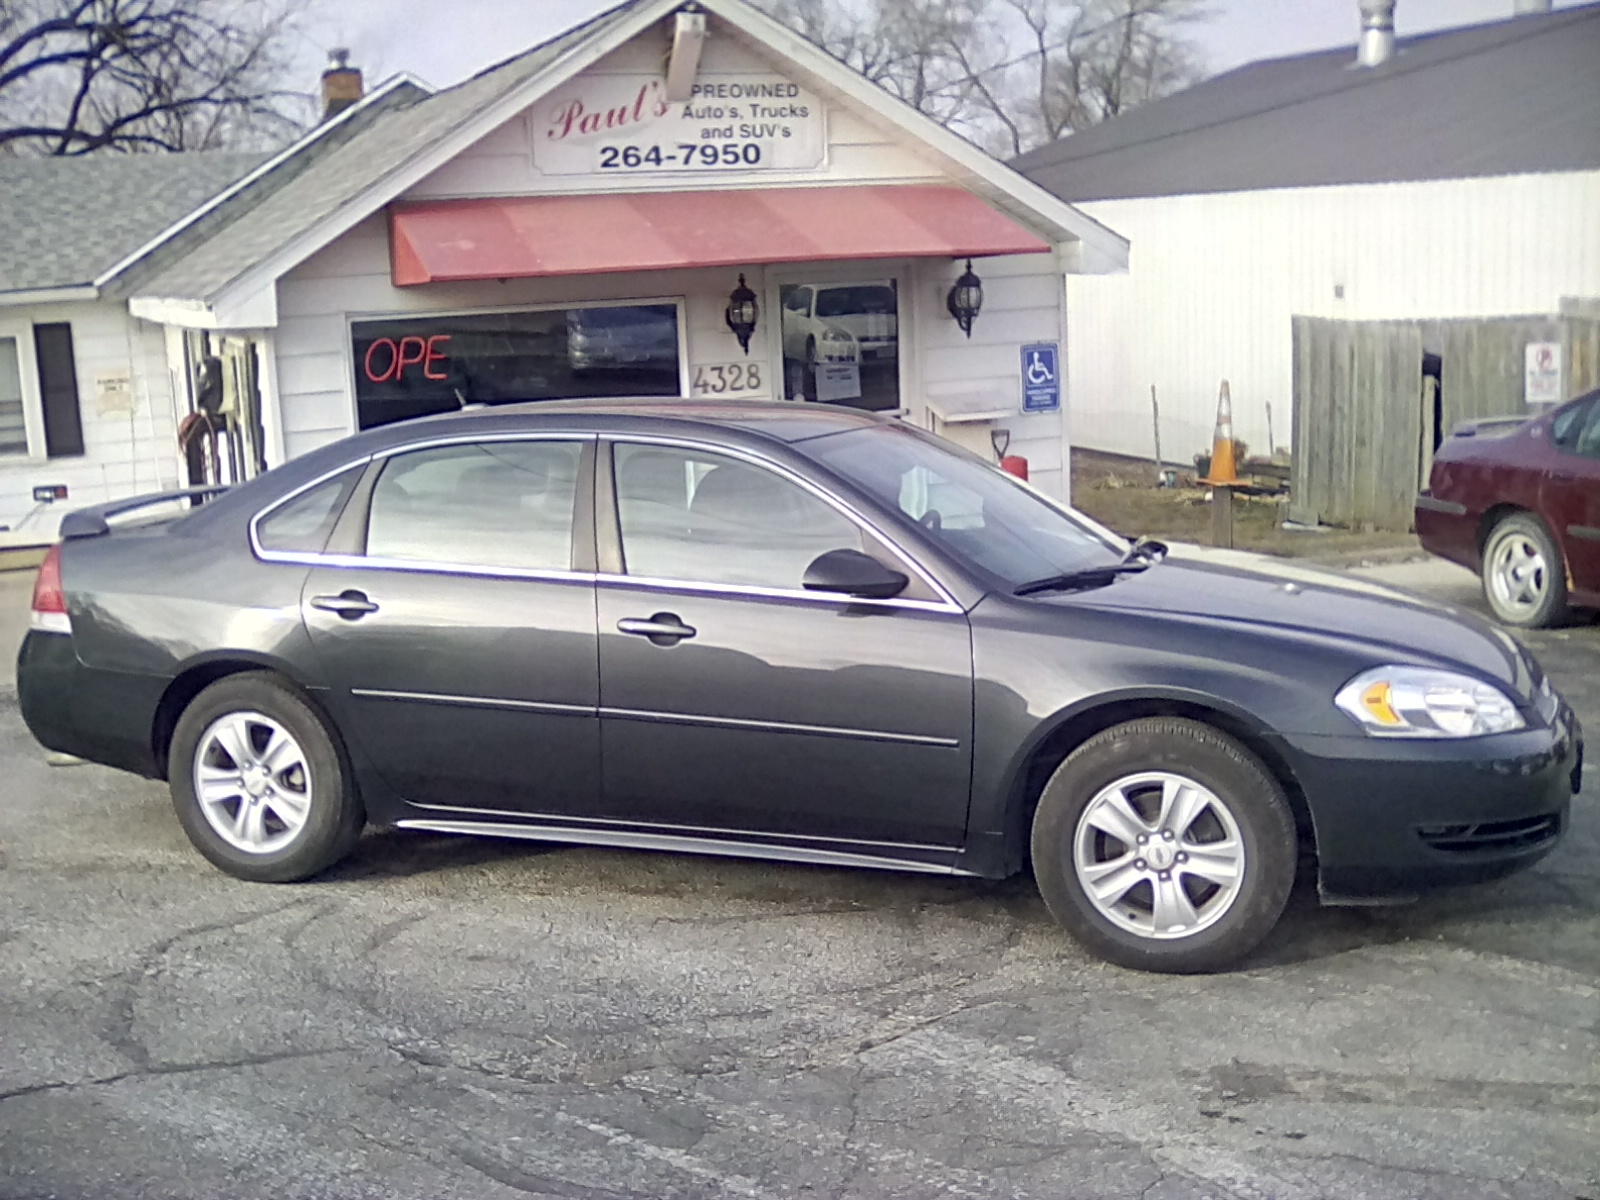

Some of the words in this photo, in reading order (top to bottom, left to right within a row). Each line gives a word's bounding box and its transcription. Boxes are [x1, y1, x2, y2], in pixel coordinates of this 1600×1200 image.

[690, 83, 799, 99] PREOWNED
[547, 81, 669, 140] Paul's
[749, 103, 809, 118] Trucks
[700, 124, 734, 139] and
[739, 123, 792, 138] SUV's
[600, 143, 762, 168] 264-7950
[693, 363, 761, 394] 4328
